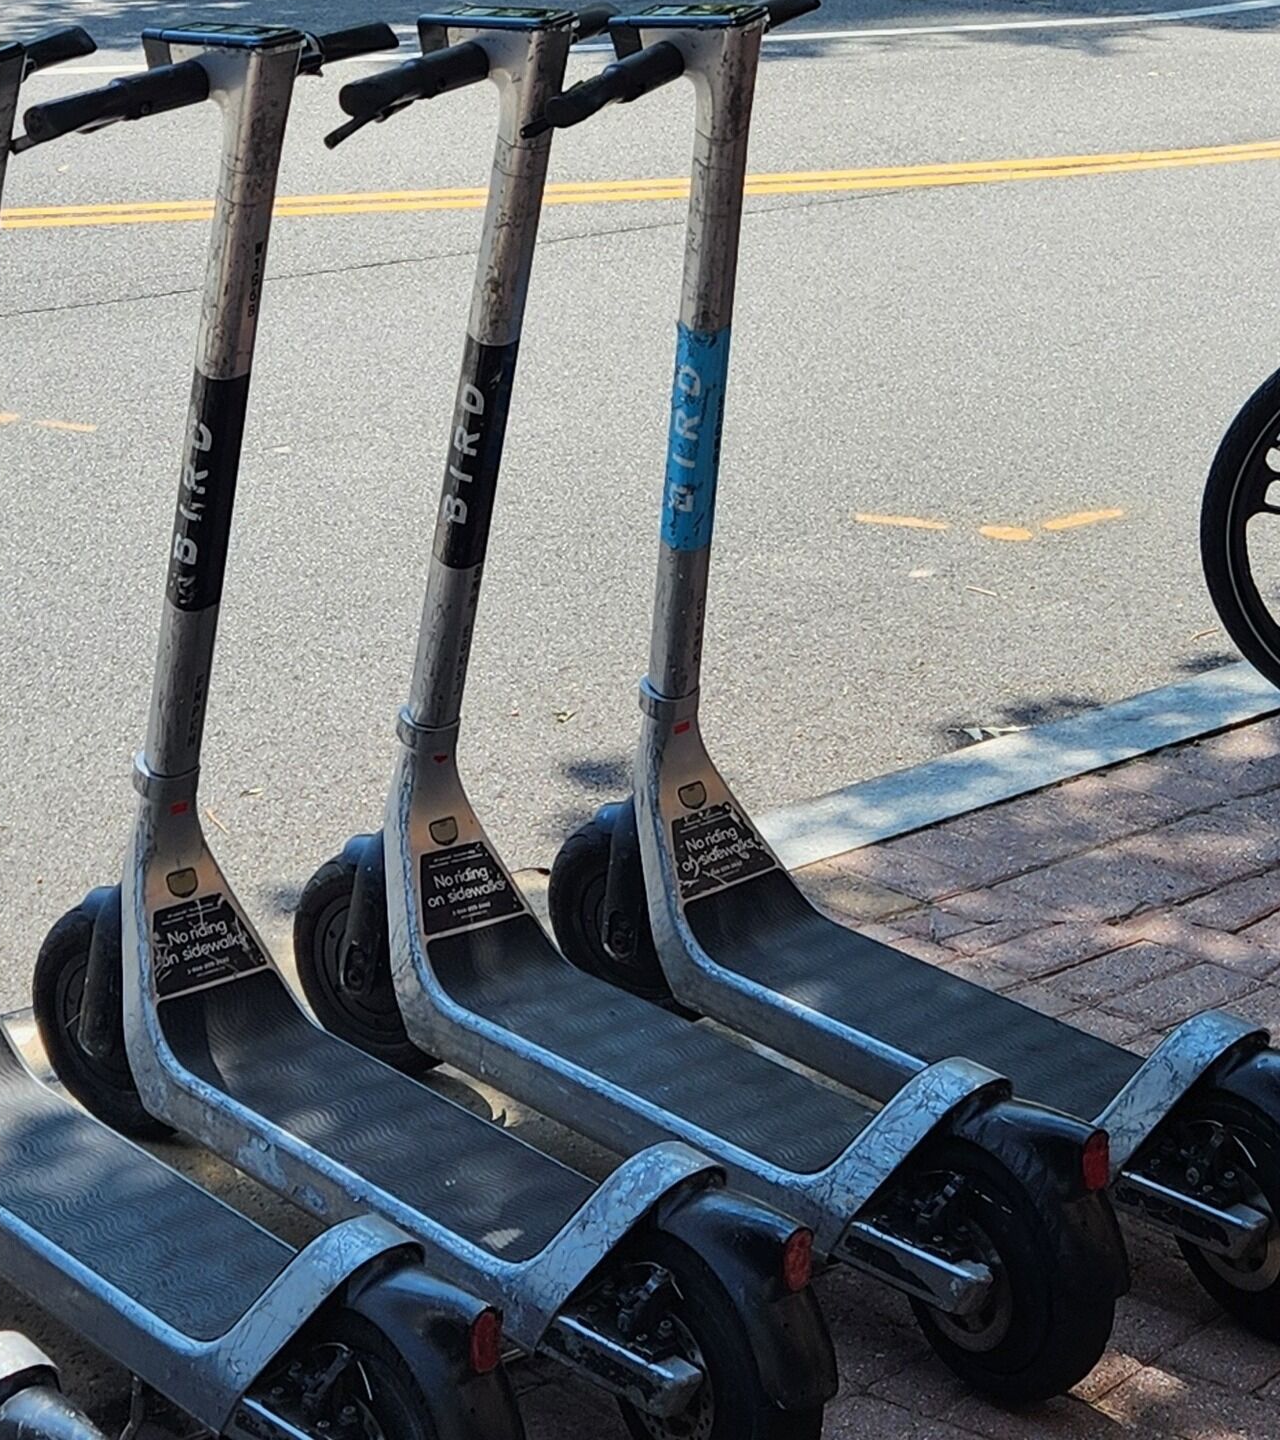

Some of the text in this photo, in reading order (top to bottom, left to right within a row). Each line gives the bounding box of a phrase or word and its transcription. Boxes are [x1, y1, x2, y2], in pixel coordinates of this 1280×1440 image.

[442, 382, 486, 525] BIRD
[685, 837, 705, 852] No
[433, 866, 489, 889] No riding
[427, 895, 445, 908] on
[166, 930, 189, 946] No
